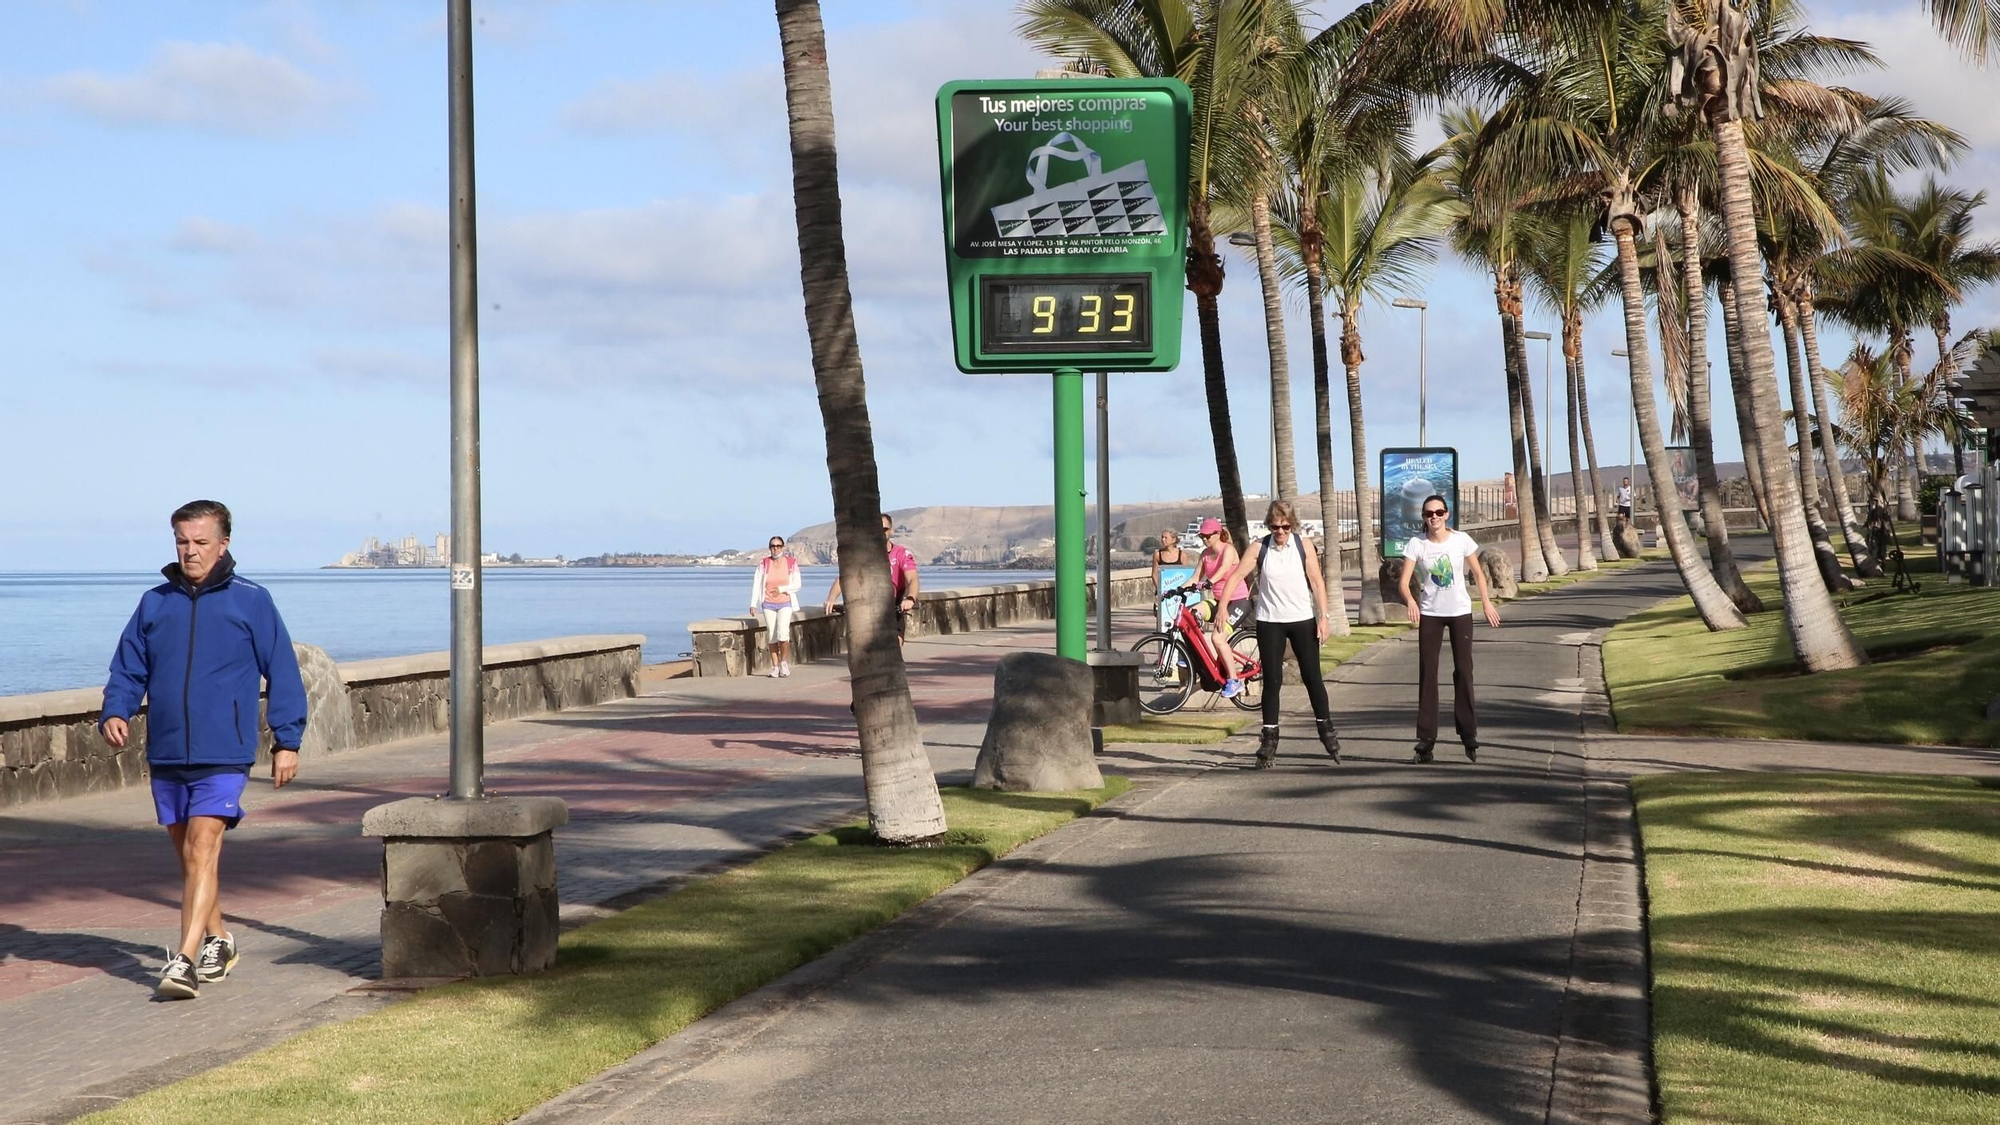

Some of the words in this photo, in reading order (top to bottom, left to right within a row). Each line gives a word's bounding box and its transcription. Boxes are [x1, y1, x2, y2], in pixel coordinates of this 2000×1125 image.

[979, 96, 1006, 114] Tus
[1010, 95, 1074, 117] mejores
[1078, 97, 1147, 115] compras
[994, 118, 1028, 132] Your
[1031, 117, 1063, 132] best
[1066, 116, 1133, 133] shopping
[981, 239, 996, 248] JOSÉ
[1104, 238, 1120, 246] FELO
[1003, 247, 1019, 255] LAS
[1020, 247, 1053, 255] PALMAS
[1067, 246, 1090, 254] GRAN
[1092, 246, 1128, 254] CANARIA
[1032, 295, 1056, 333] 9
